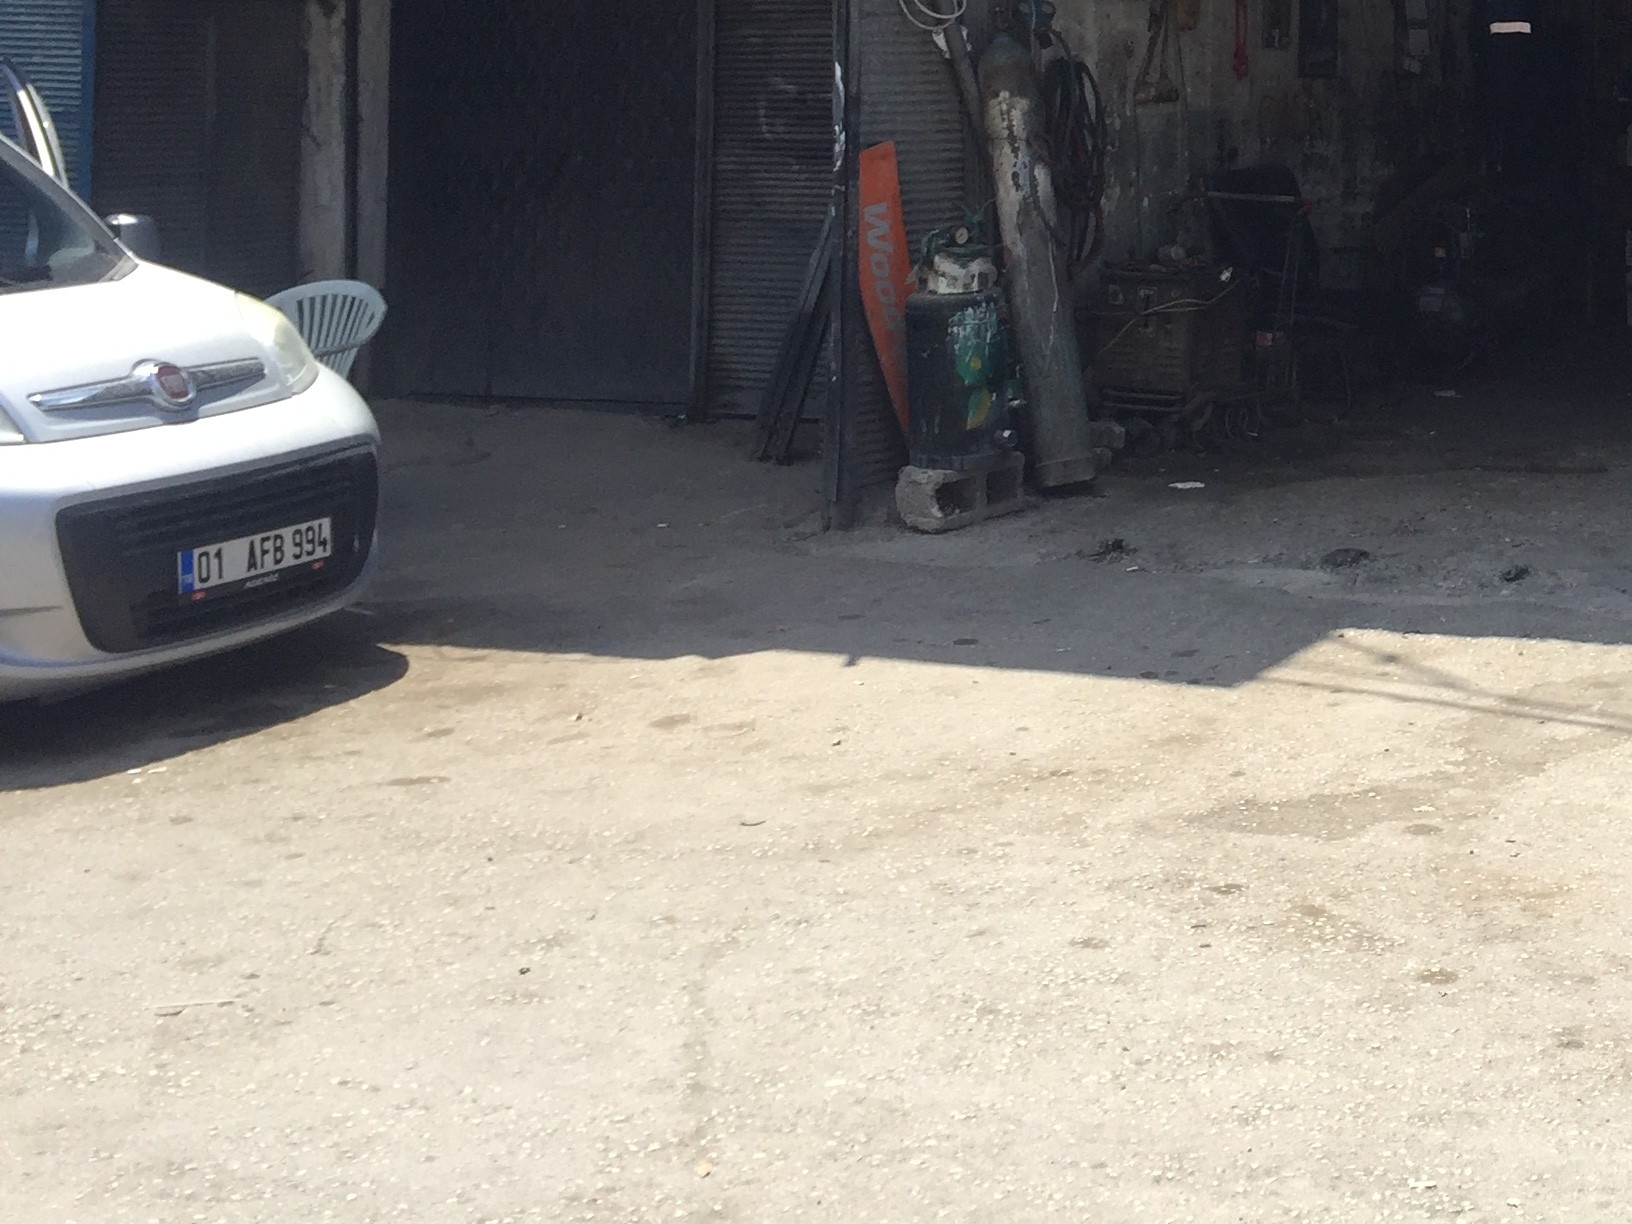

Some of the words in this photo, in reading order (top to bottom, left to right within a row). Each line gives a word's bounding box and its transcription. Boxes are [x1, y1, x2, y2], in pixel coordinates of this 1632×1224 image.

[197, 547, 224, 584] 01
[246, 533, 286, 573] AFB
[292, 523, 329, 560] 994
